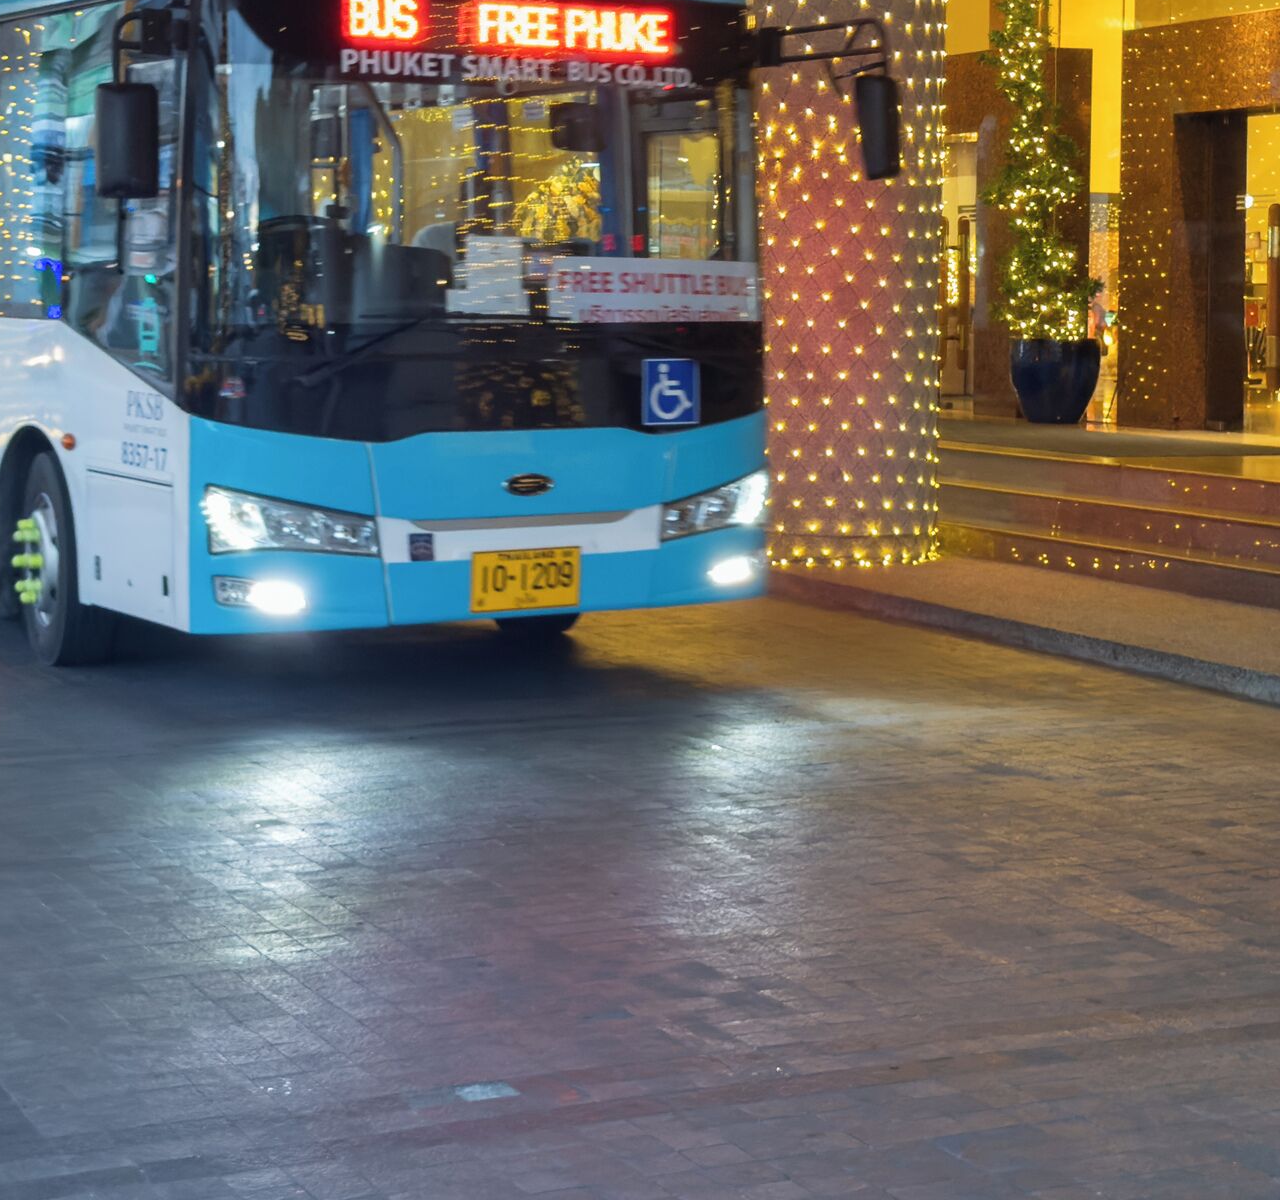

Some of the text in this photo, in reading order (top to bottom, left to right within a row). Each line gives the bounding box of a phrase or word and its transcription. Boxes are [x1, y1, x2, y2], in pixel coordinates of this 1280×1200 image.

[477, 3, 560, 49] FREE
[340, 48, 455, 79] PHUKET
[460, 56, 556, 83] SMART
[566, 62, 611, 85] BUS
[558, 271, 613, 294] FREE
[619, 272, 711, 296] SHUTTLE
[127, 390, 164, 421] PKSB
[481, 560, 573, 595] 10-1209
